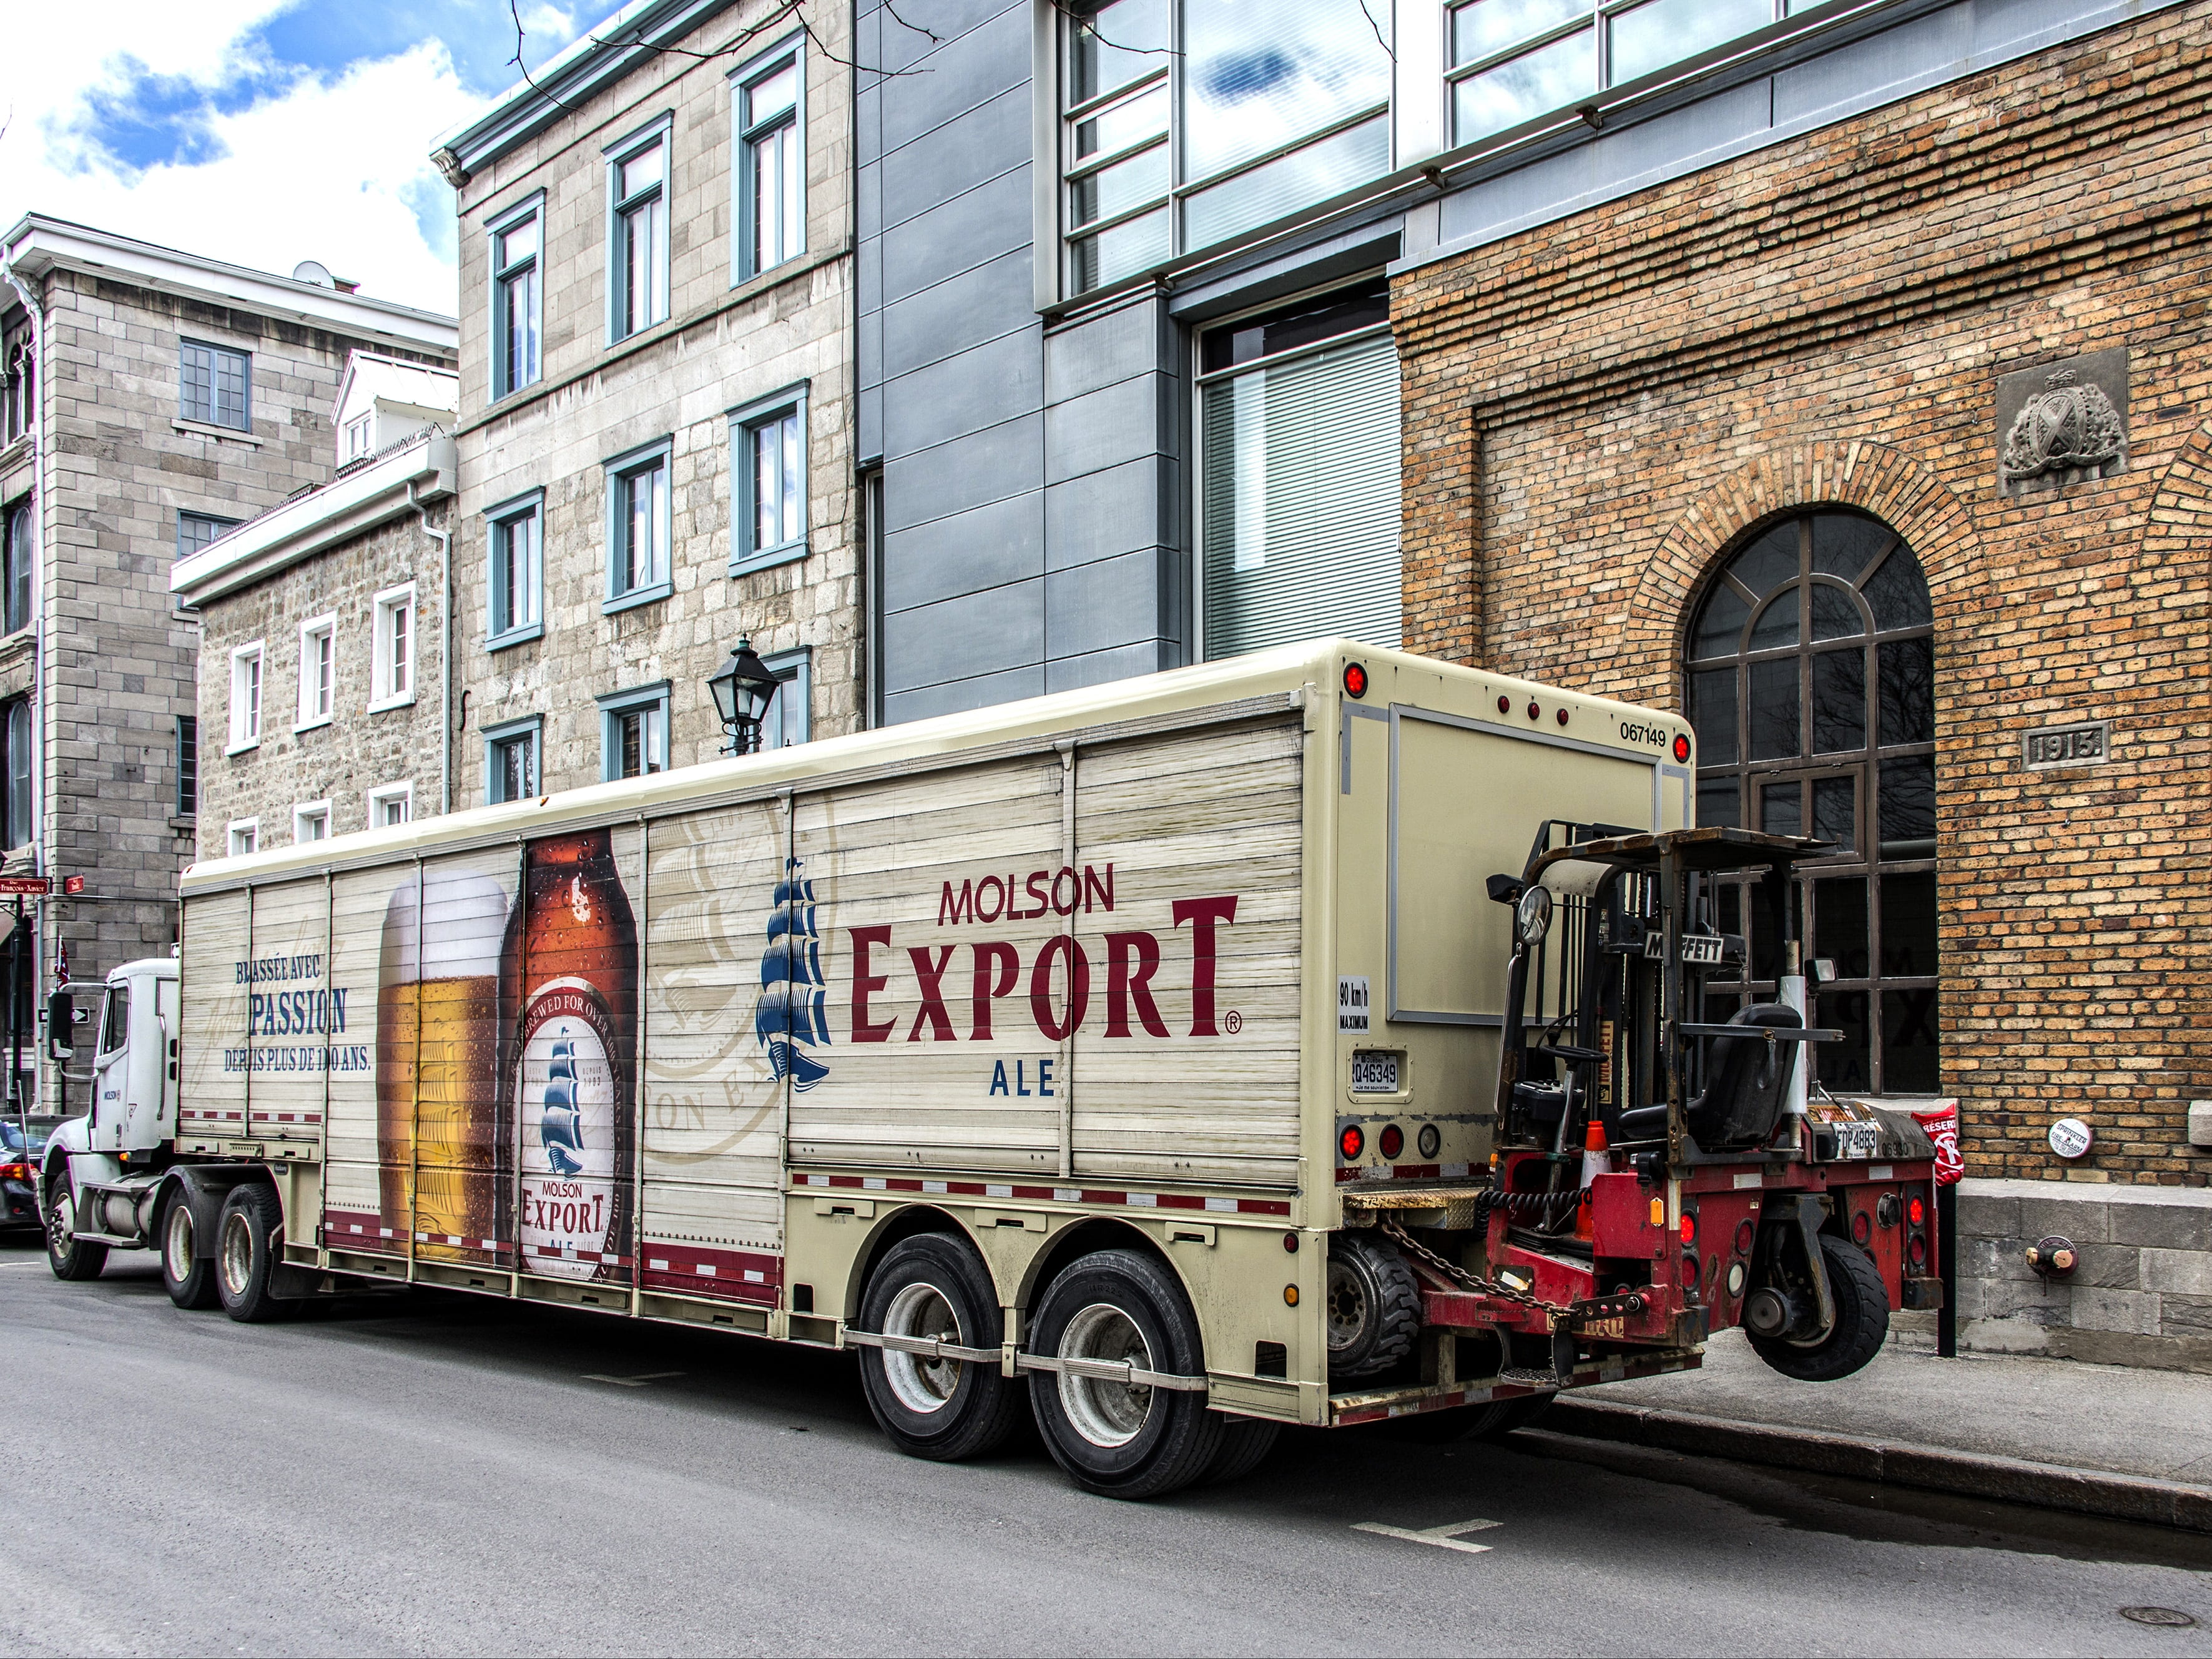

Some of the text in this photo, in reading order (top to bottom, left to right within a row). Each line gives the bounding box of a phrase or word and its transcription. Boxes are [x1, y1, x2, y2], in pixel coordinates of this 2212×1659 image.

[1620, 722, 1666, 747] 067149
[938, 862, 1114, 927] MOLSON
[290, 954, 320, 979] AVEC
[847, 895, 1238, 1043] EXPORT
[1340, 980, 1368, 1009] 90 km/h
[250, 988, 348, 1036] PASSION
[1340, 1015, 1368, 1030] MAXIMUM
[524, 996, 561, 1038] BREWED
[564, 995, 583, 1013] FOR
[586, 1003, 608, 1036] OVER
[606, 1036, 617, 1061] 100
[225, 1048, 265, 1072] DEPUIS
[267, 1047, 296, 1071] PLUS
[299, 1047, 315, 1071] DE
[341, 1046, 371, 1071] ANS.
[582, 1066, 601, 1075] DEPUIS
[990, 1060, 1054, 1096] ALE
[2057, 1124, 2087, 1145] SPRINKLER
[542, 1181, 582, 1198] MOLSON
[522, 1188, 604, 1234] EXPORT
